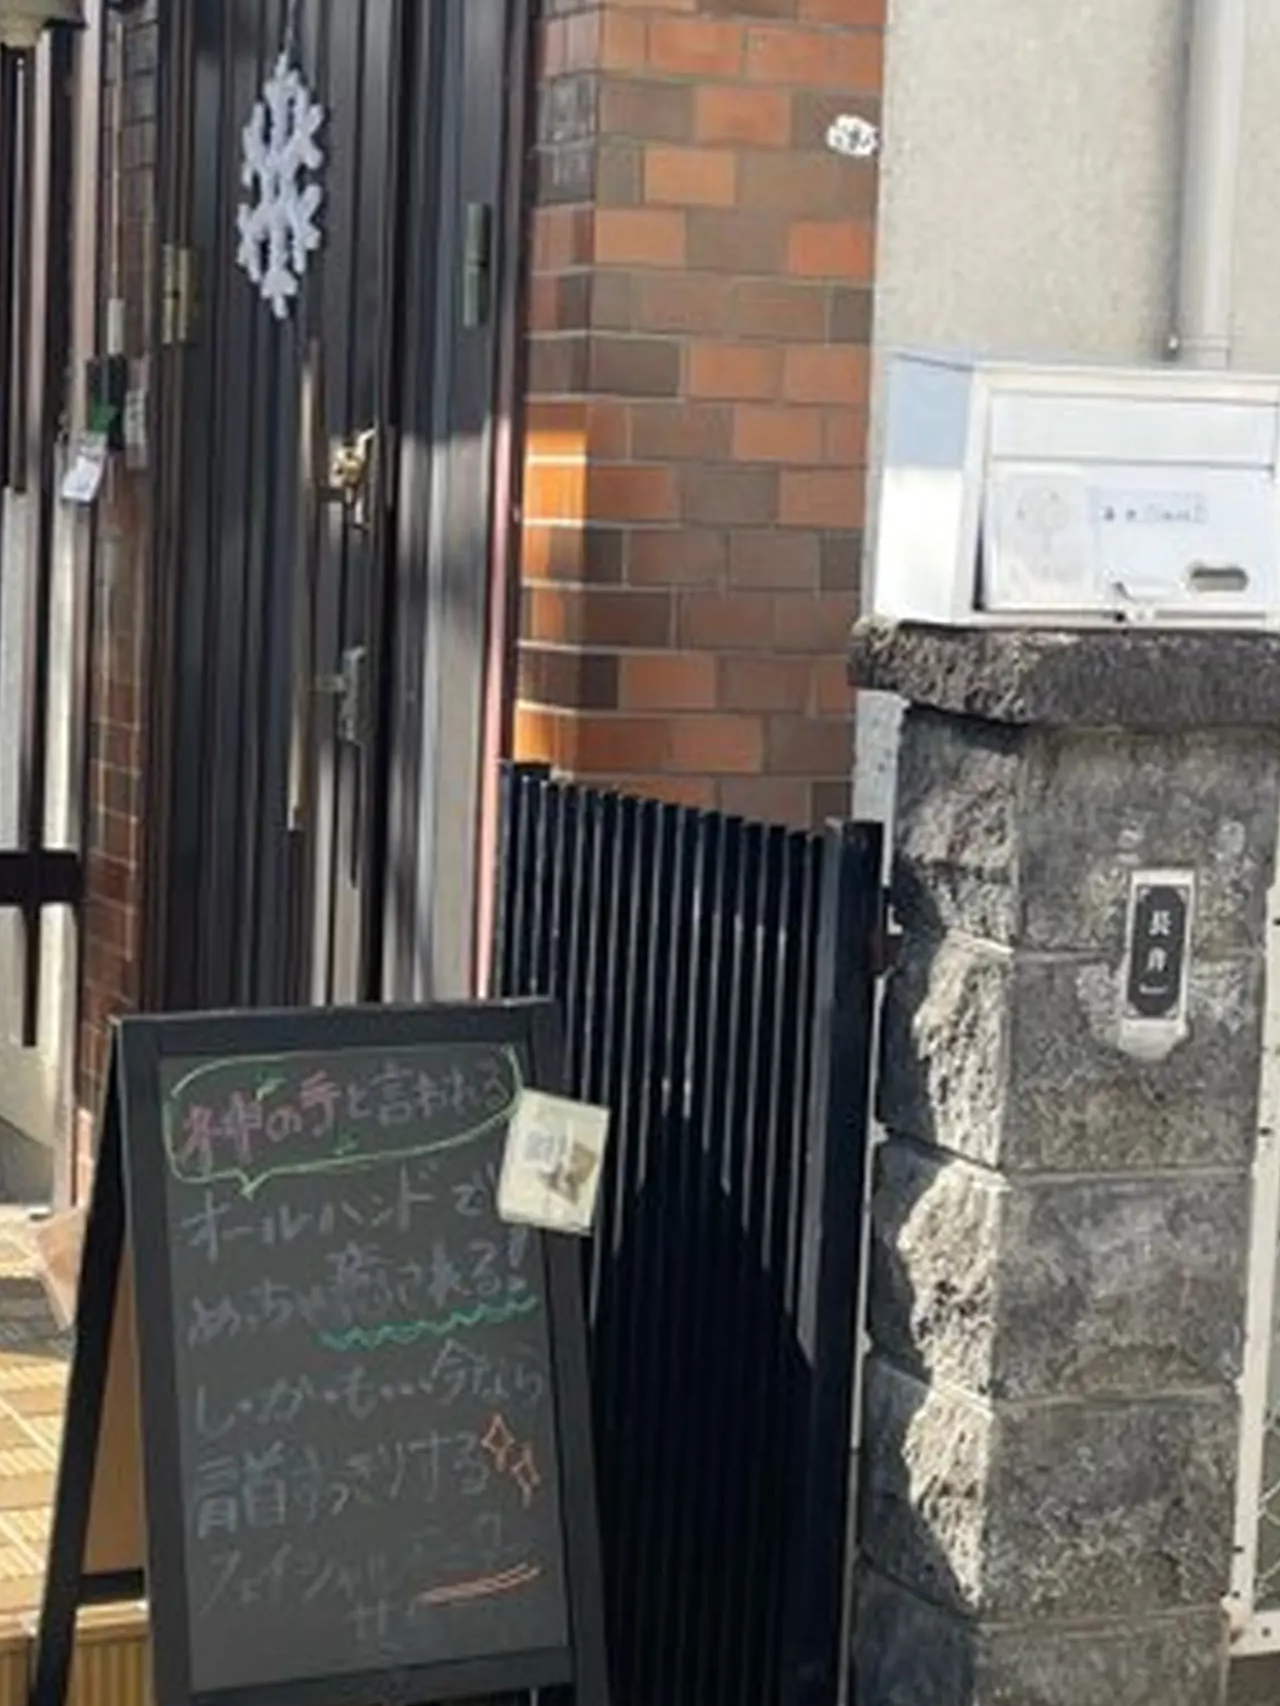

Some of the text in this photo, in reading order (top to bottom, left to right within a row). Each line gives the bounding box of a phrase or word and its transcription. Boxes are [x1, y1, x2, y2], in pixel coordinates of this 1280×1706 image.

[181, 1059, 510, 1176] 神の手と言われる
